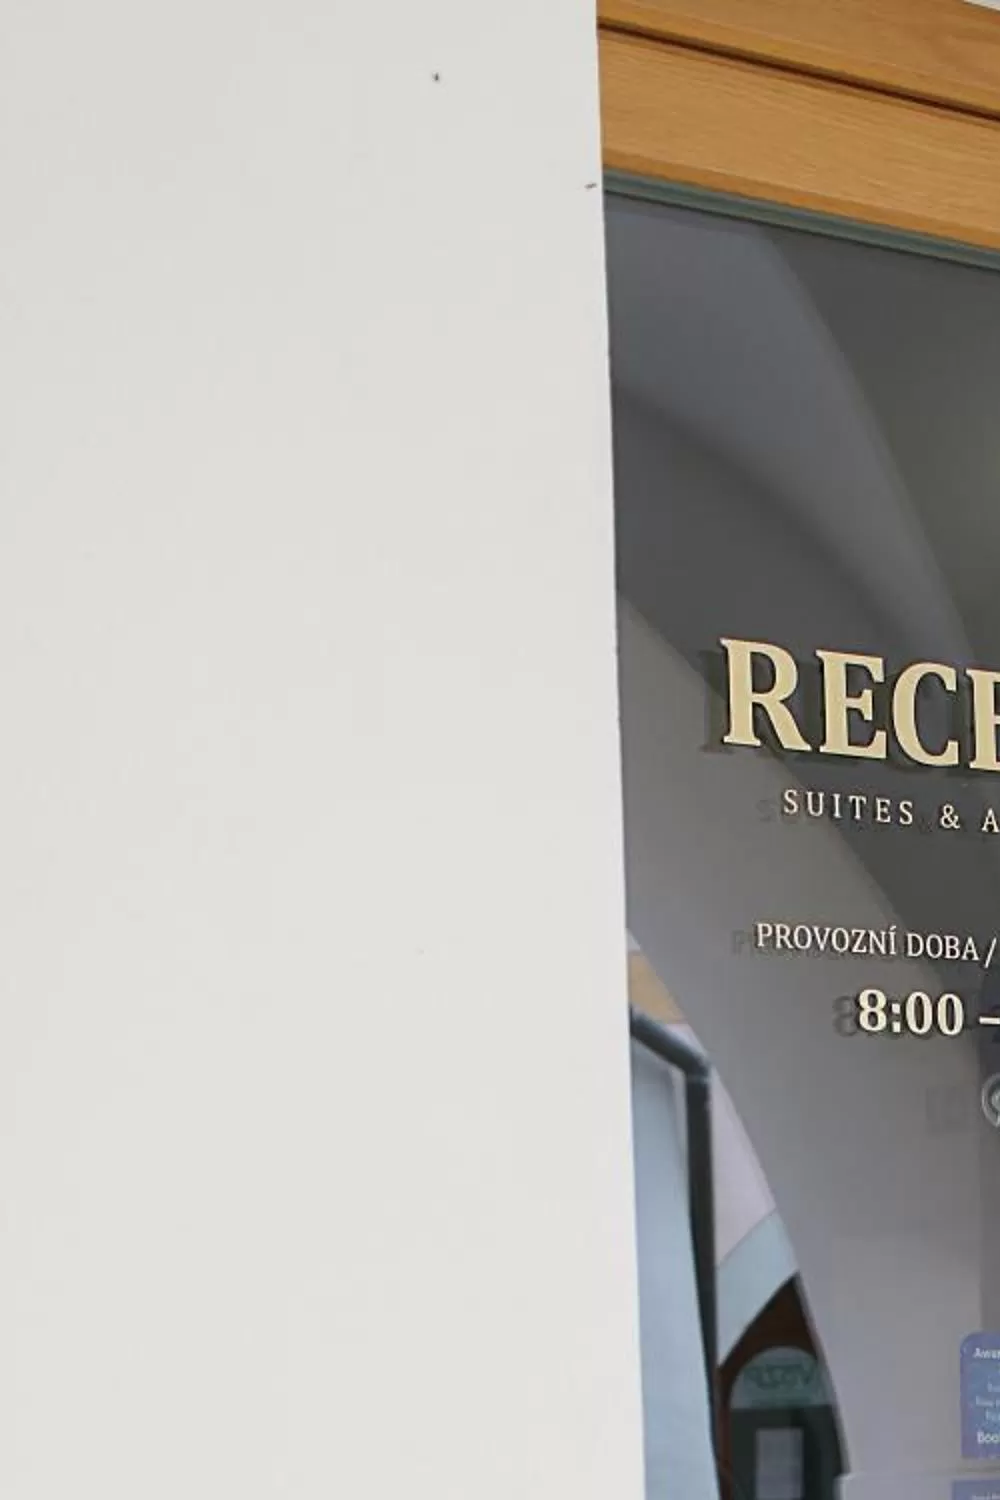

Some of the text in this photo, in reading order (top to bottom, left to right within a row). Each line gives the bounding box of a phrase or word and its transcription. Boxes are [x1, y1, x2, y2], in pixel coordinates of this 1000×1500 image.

[783, 788, 913, 825] SUITES
[940, 804, 961, 830] &
[756, 922, 897, 954] PROVOZNÍ
[907, 933, 979, 962] DOBA
[984, 938, 998, 968] /
[858, 988, 964, 1036] 8:00
